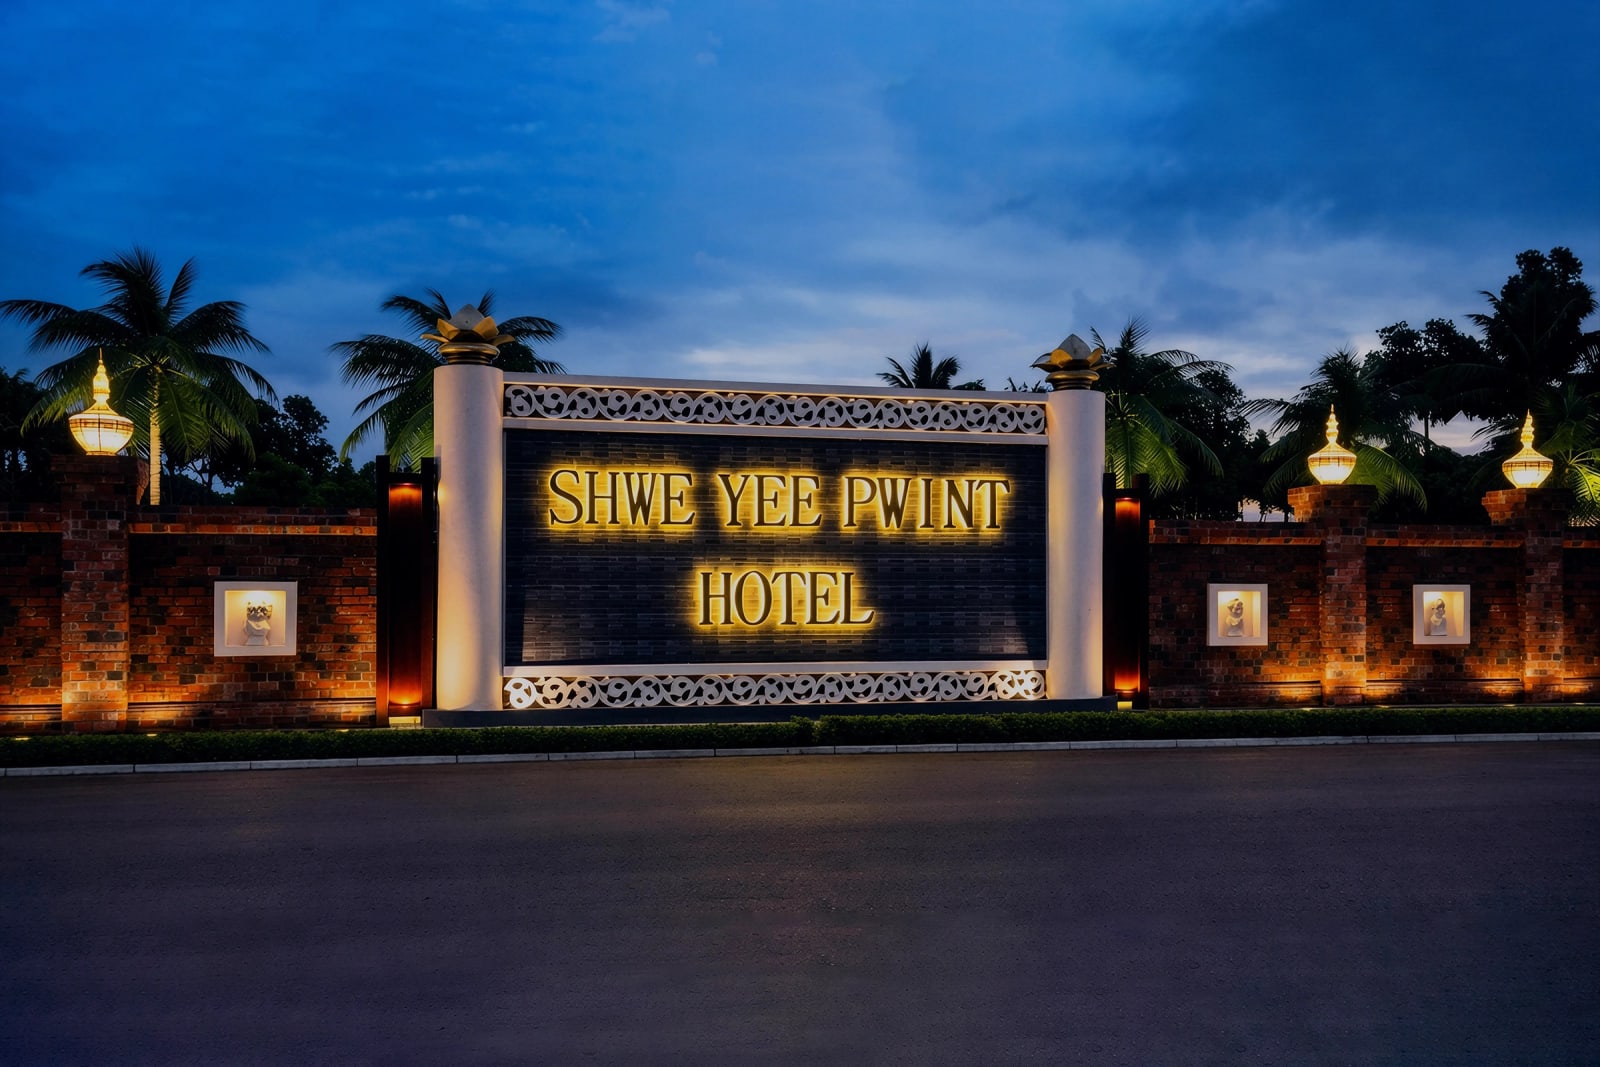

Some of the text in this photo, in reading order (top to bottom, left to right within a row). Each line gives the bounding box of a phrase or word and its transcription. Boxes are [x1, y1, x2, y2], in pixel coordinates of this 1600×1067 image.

[548, 469, 1011, 530] SHWE YEE PWINT
[698, 570, 876, 627] HOTEL
